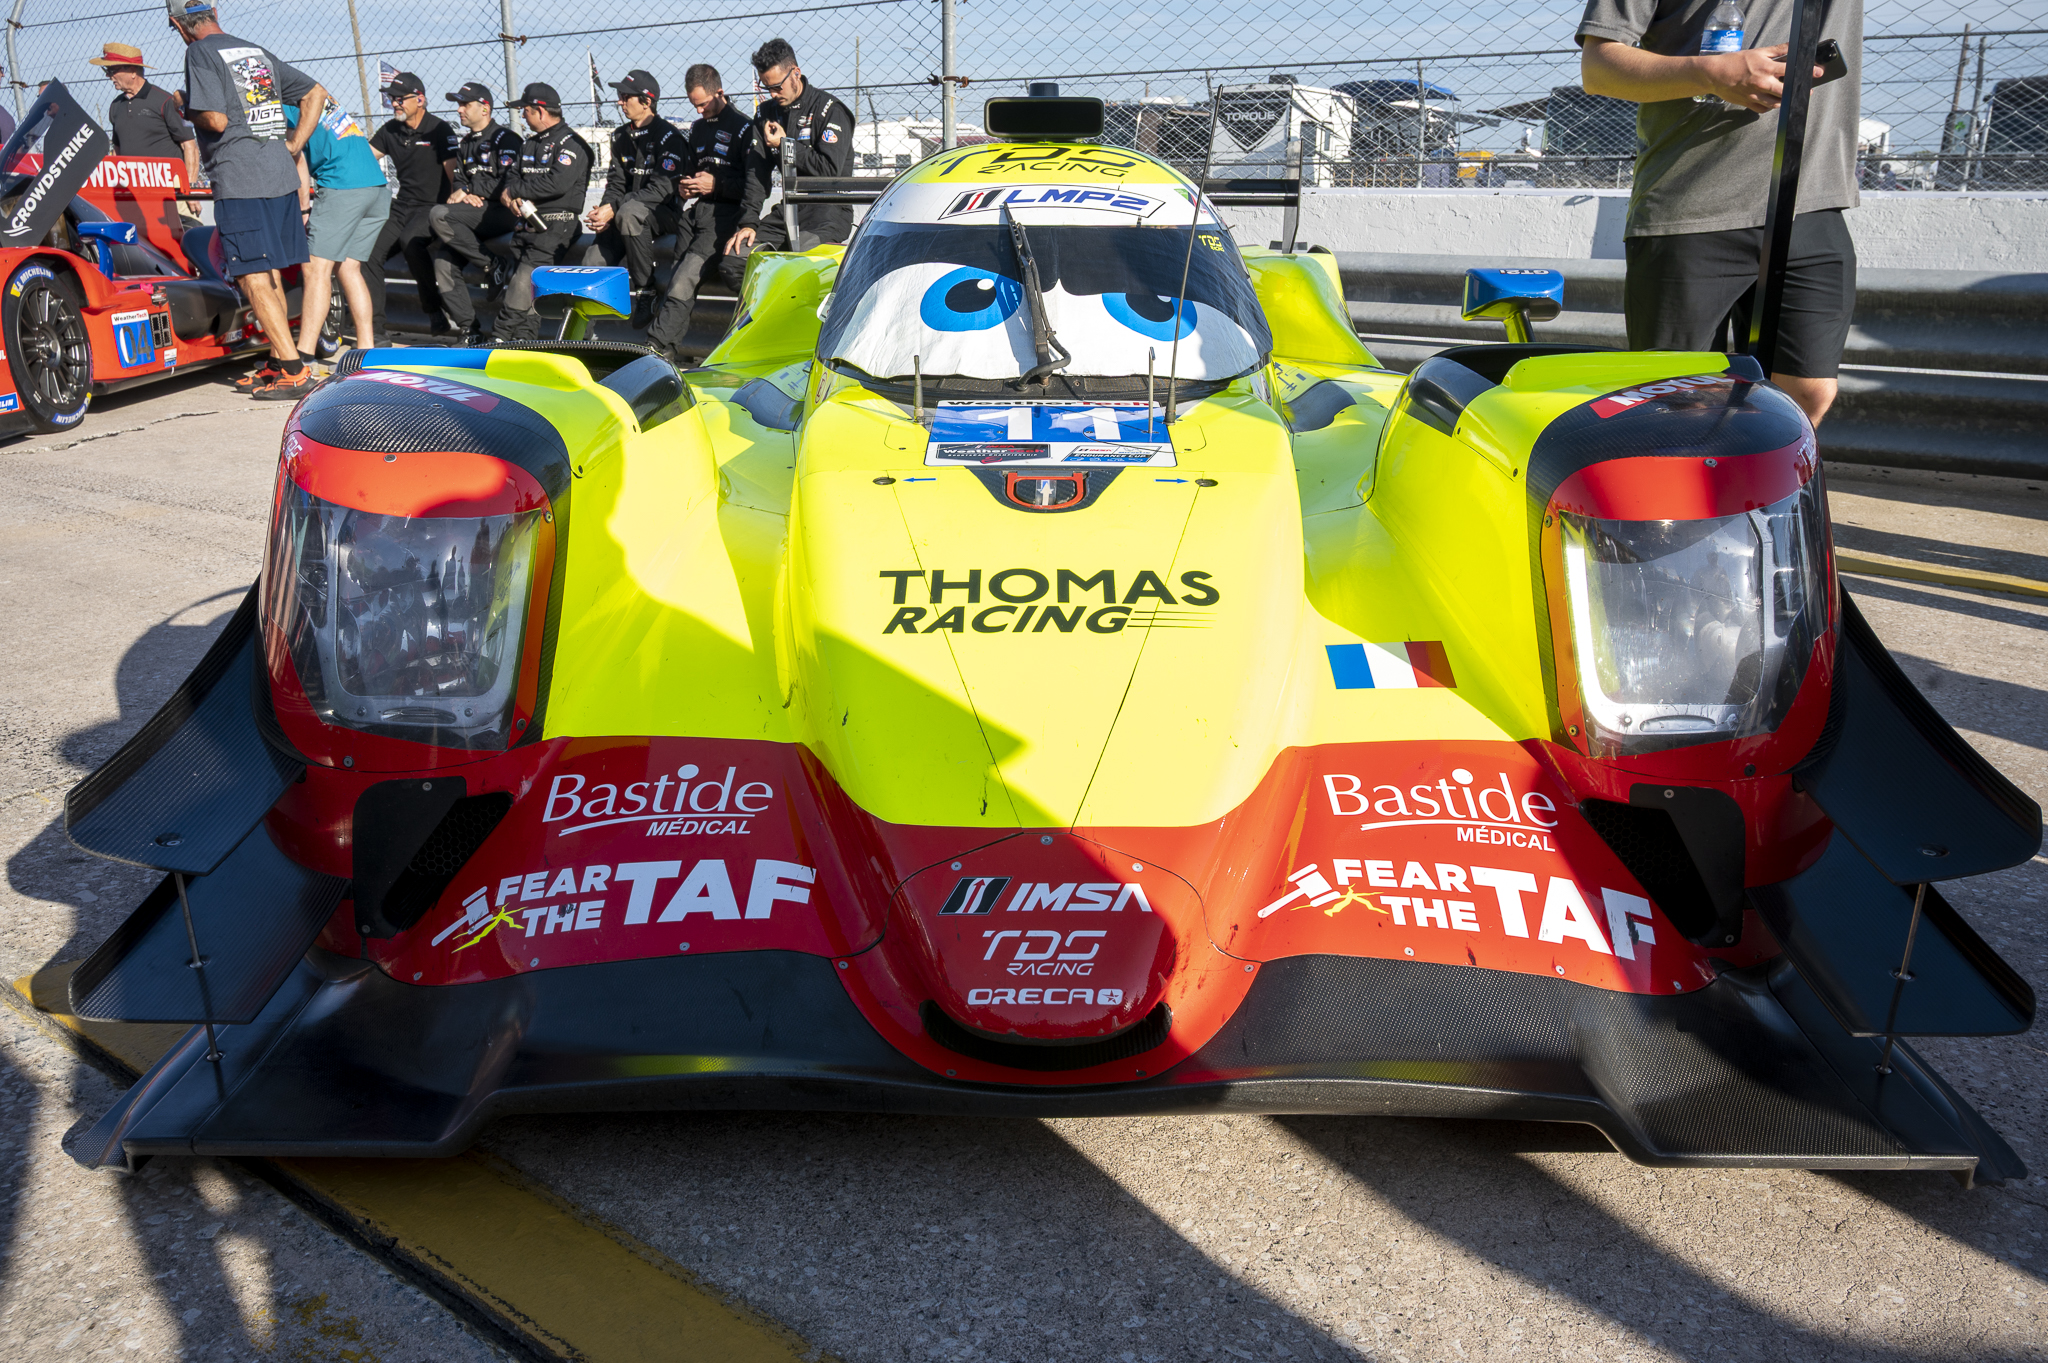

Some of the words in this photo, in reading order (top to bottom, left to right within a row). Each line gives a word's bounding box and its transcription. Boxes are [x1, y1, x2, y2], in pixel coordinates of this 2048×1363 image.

[1225, 110, 1276, 121] TORQUE
[11, 123, 95, 229] CROWDSTRIKE
[938, 146, 1148, 177] TDS
[977, 161, 1130, 178] RACING
[1003, 189, 1150, 212] LMP2
[20, 267, 53, 284] MICHELIN
[113, 312, 148, 322] WeatherTech
[119, 322, 152, 365] 04
[351, 371, 483, 402] MOTUL
[1608, 375, 1736, 407] MOTUL
[879, 568, 1220, 606] THOMAS
[882, 605, 1133, 634] RACING
[542, 763, 774, 823] Bastide
[1323, 768, 1558, 828] Bastide
[645, 817, 752, 838] MÉDICAL
[1456, 825, 1556, 852] MÉDICAL
[495, 864, 612, 907] FEAR
[1332, 858, 1472, 894] FEAR
[614, 858, 818, 926] TAF
[1006, 882, 1153, 912] IMSA
[521, 898, 606, 939] THE
[1379, 895, 1481, 932] THE
[1469, 865, 1657, 962] TAF
[982, 930, 1108, 961] TDS
[1006, 962, 1095, 976] RACING
[967, 988, 1094, 1005] ORECA
